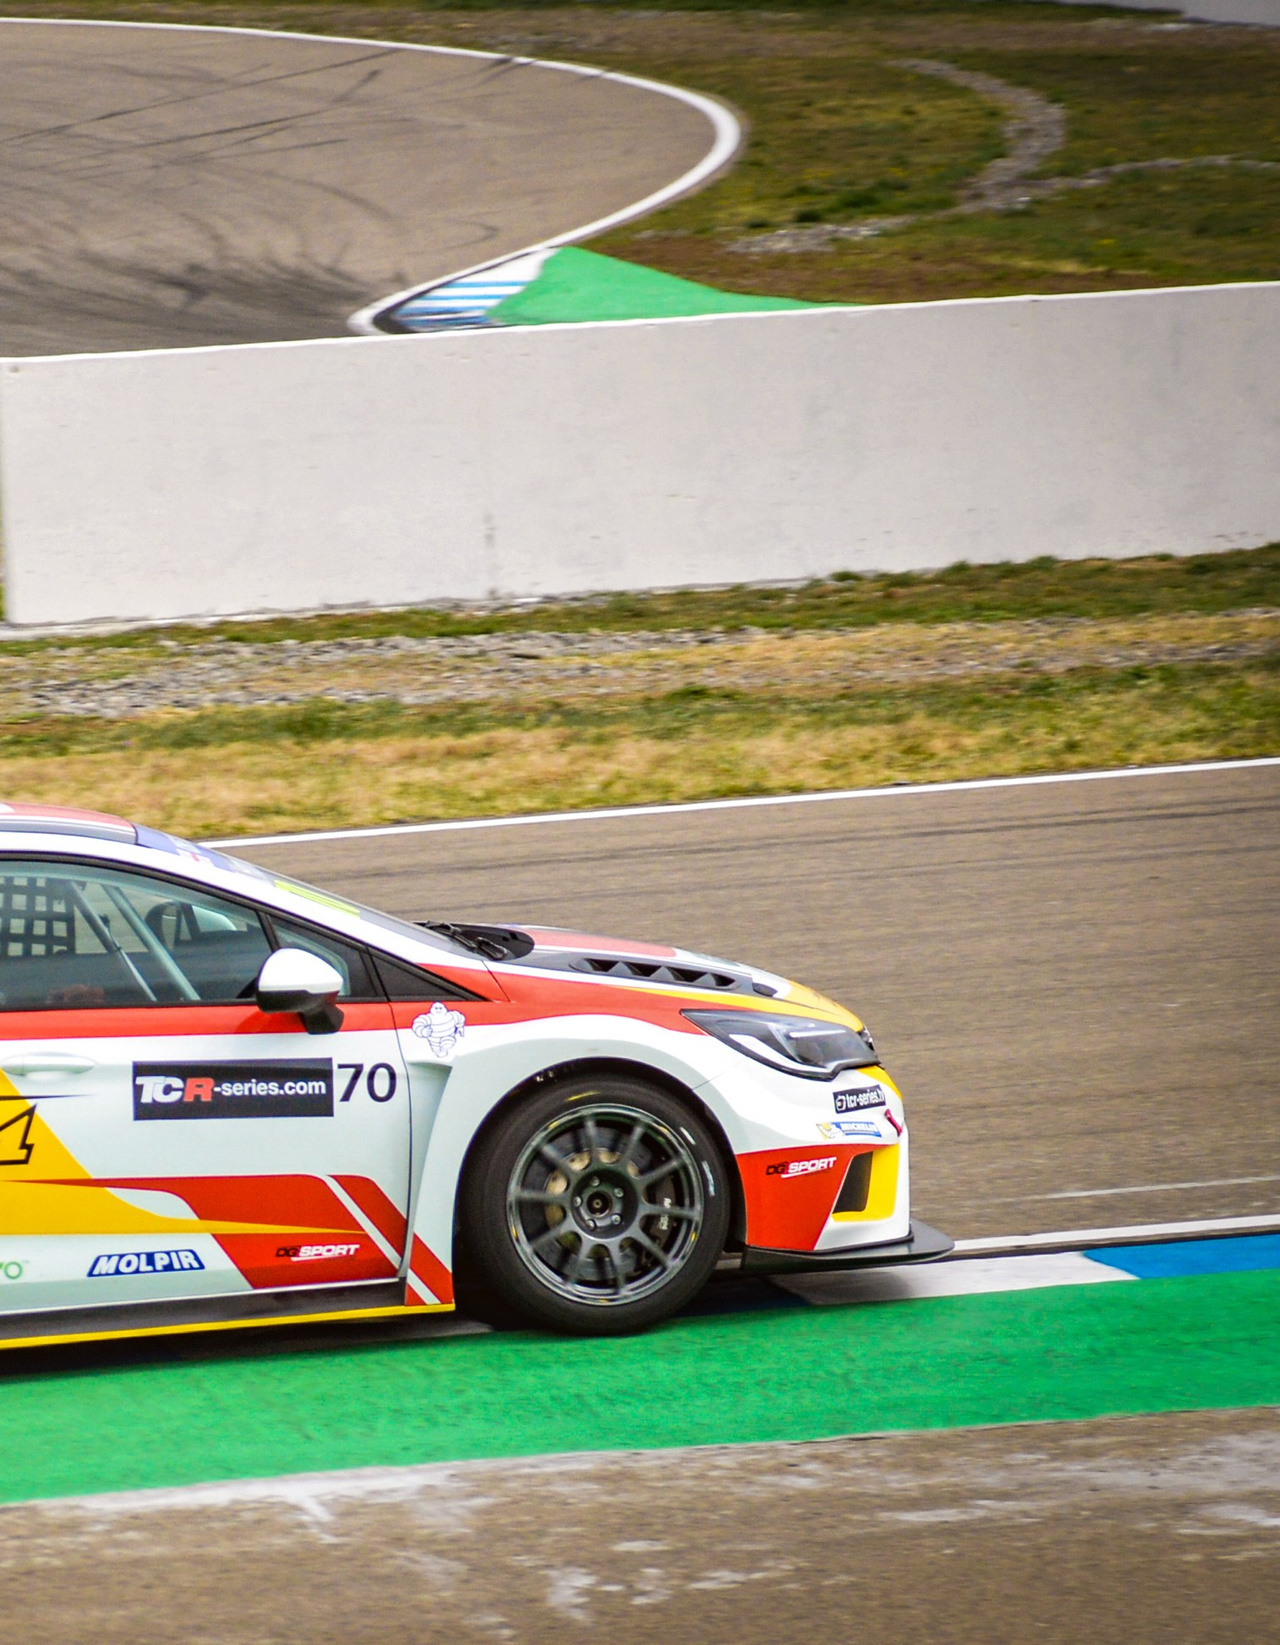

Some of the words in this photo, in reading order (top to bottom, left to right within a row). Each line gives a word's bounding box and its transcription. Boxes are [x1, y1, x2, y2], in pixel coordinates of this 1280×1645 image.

[135, 1075, 326, 1104] TCR-series.com
[337, 1062, 397, 1103] 70
[787, 1156, 837, 1174] SPORT
[92, 1250, 201, 1275] MOLPIR
[298, 1244, 360, 1258] SPORT
